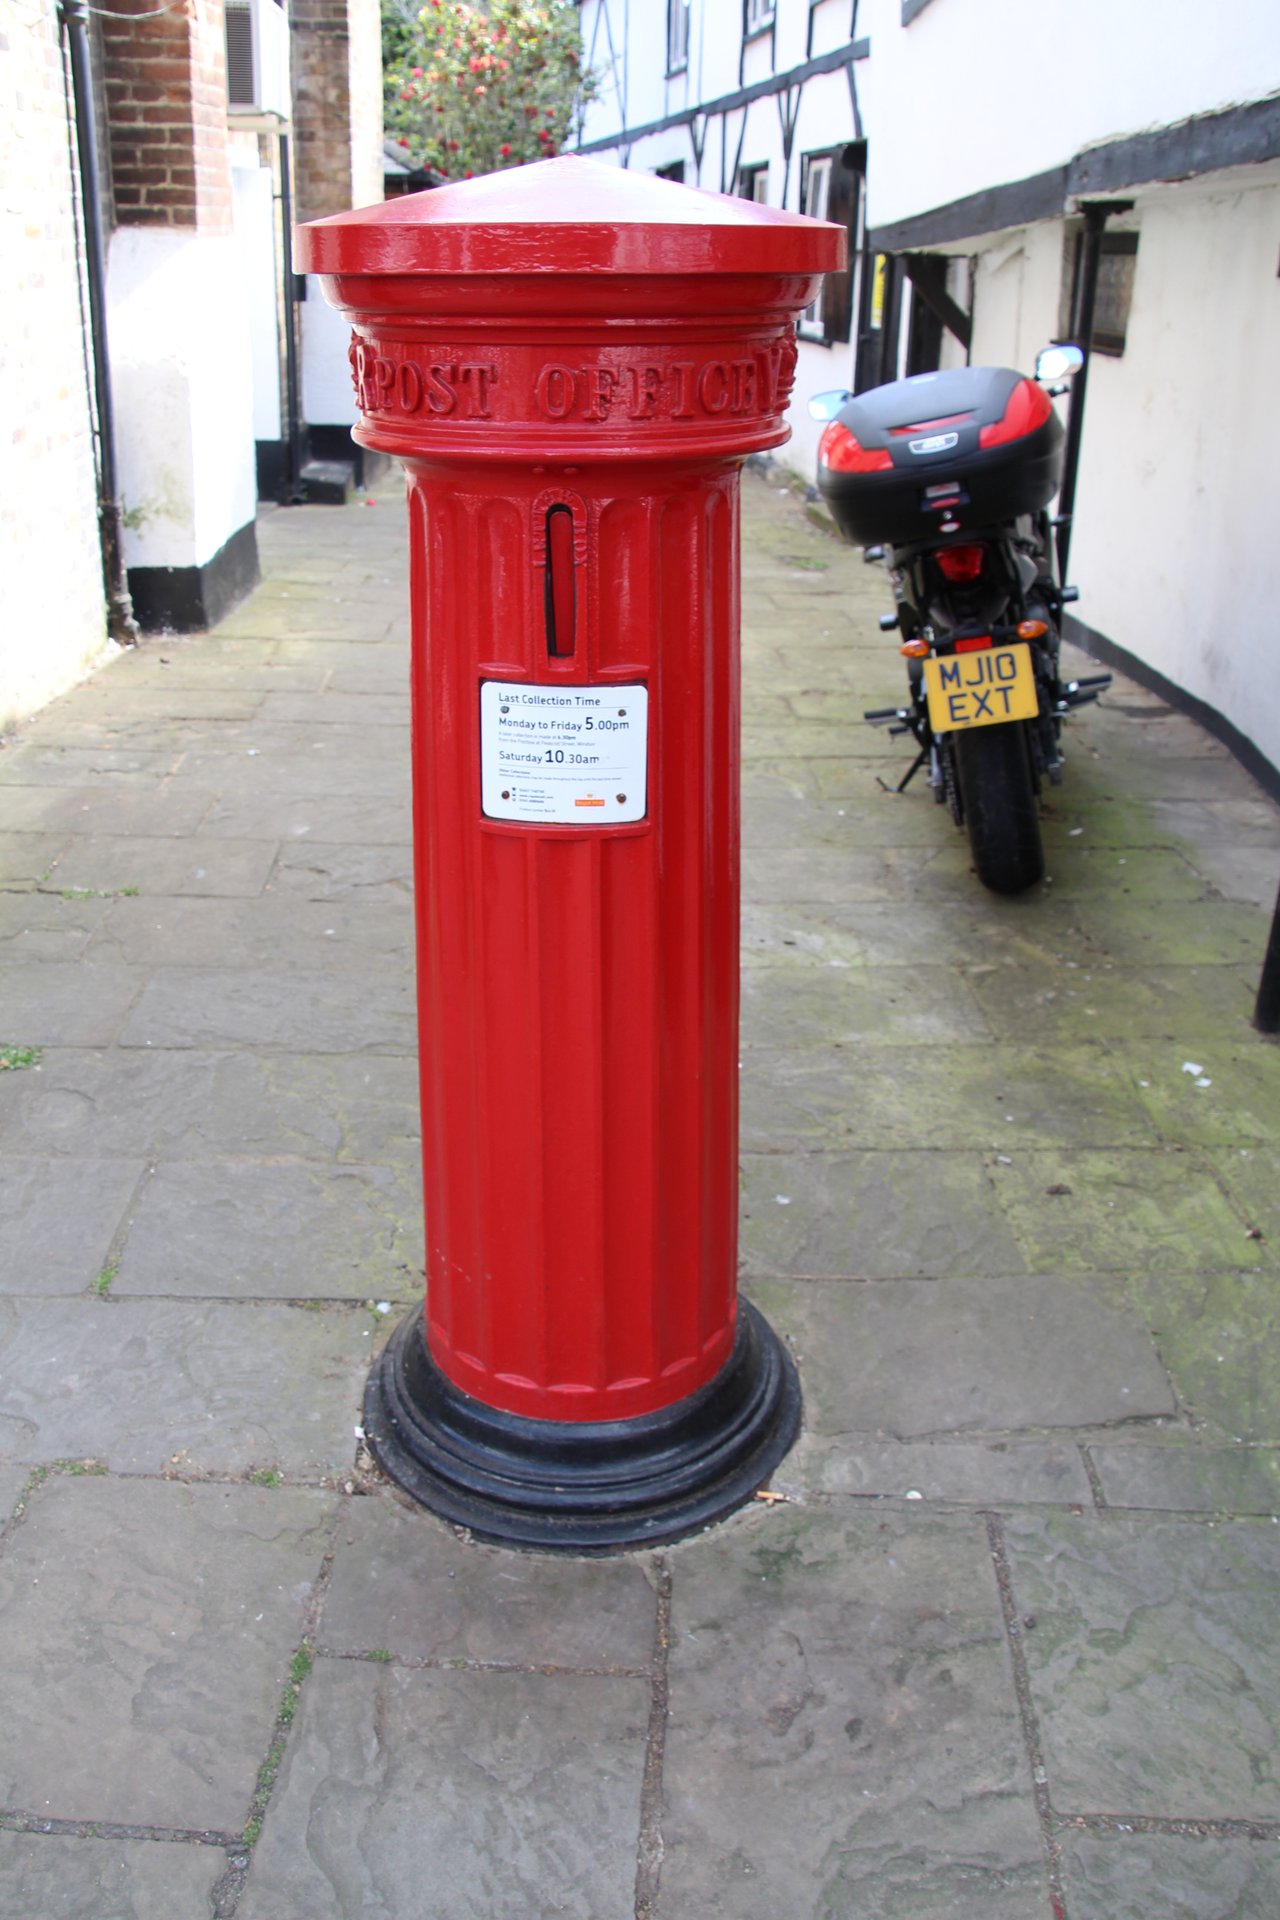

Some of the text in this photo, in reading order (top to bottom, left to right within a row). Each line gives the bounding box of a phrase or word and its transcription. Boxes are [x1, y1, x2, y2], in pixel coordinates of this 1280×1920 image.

[373, 357, 757, 420] POST OFFICE
[939, 652, 1017, 691] MJ10
[498, 692, 601, 706] Last Collection Time
[948, 685, 1014, 722] EXT
[498, 716, 630, 732] Monday to Friday 5.00pm
[499, 749, 600, 764] Saturday 10.30am
